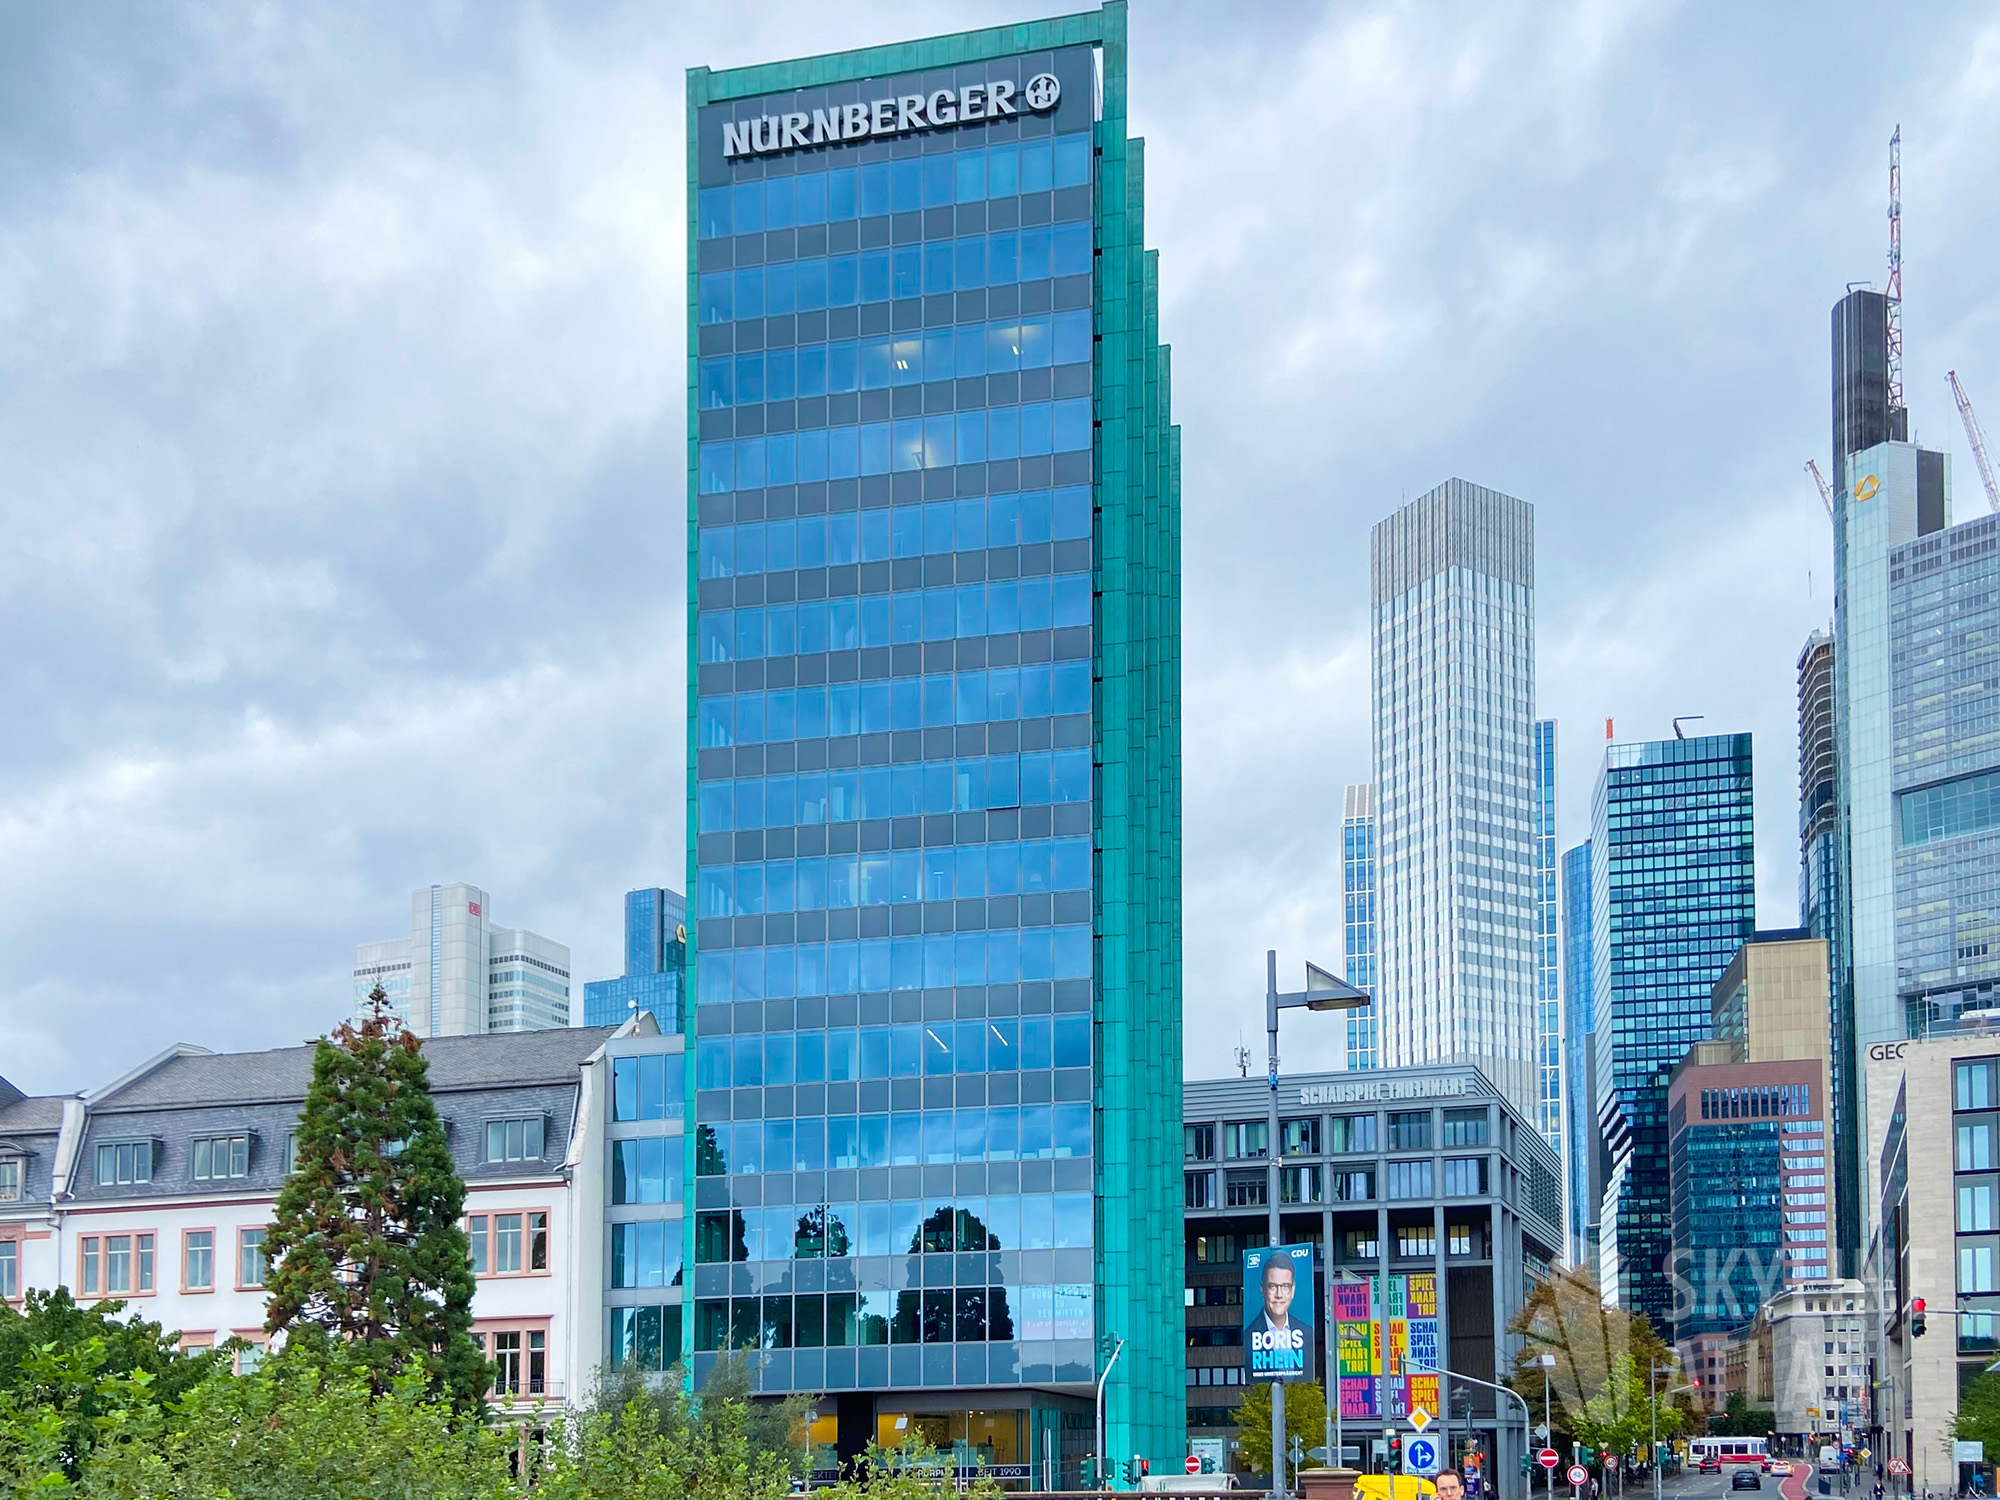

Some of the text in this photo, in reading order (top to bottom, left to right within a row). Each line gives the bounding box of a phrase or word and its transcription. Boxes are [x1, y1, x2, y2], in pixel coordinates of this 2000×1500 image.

[722, 80, 1017, 157] NÜRNBERGER
[1300, 1083, 1386, 1105] SCHAUSPIEL
[1291, 1249, 1308, 1258] CDU
[1409, 1279, 1434, 1291] SPIEL
[1252, 1329, 1303, 1350] BORIS
[1410, 1334, 1435, 1346] SPIEL
[1252, 1349, 1303, 1369] RHEIN
[1340, 1378, 1369, 1390] SCHAU
[1340, 1390, 1363, 1402] SPIEL
[1411, 1389, 1436, 1401] SPIEL
[1000, 1466, 1022, 1476] 1990
